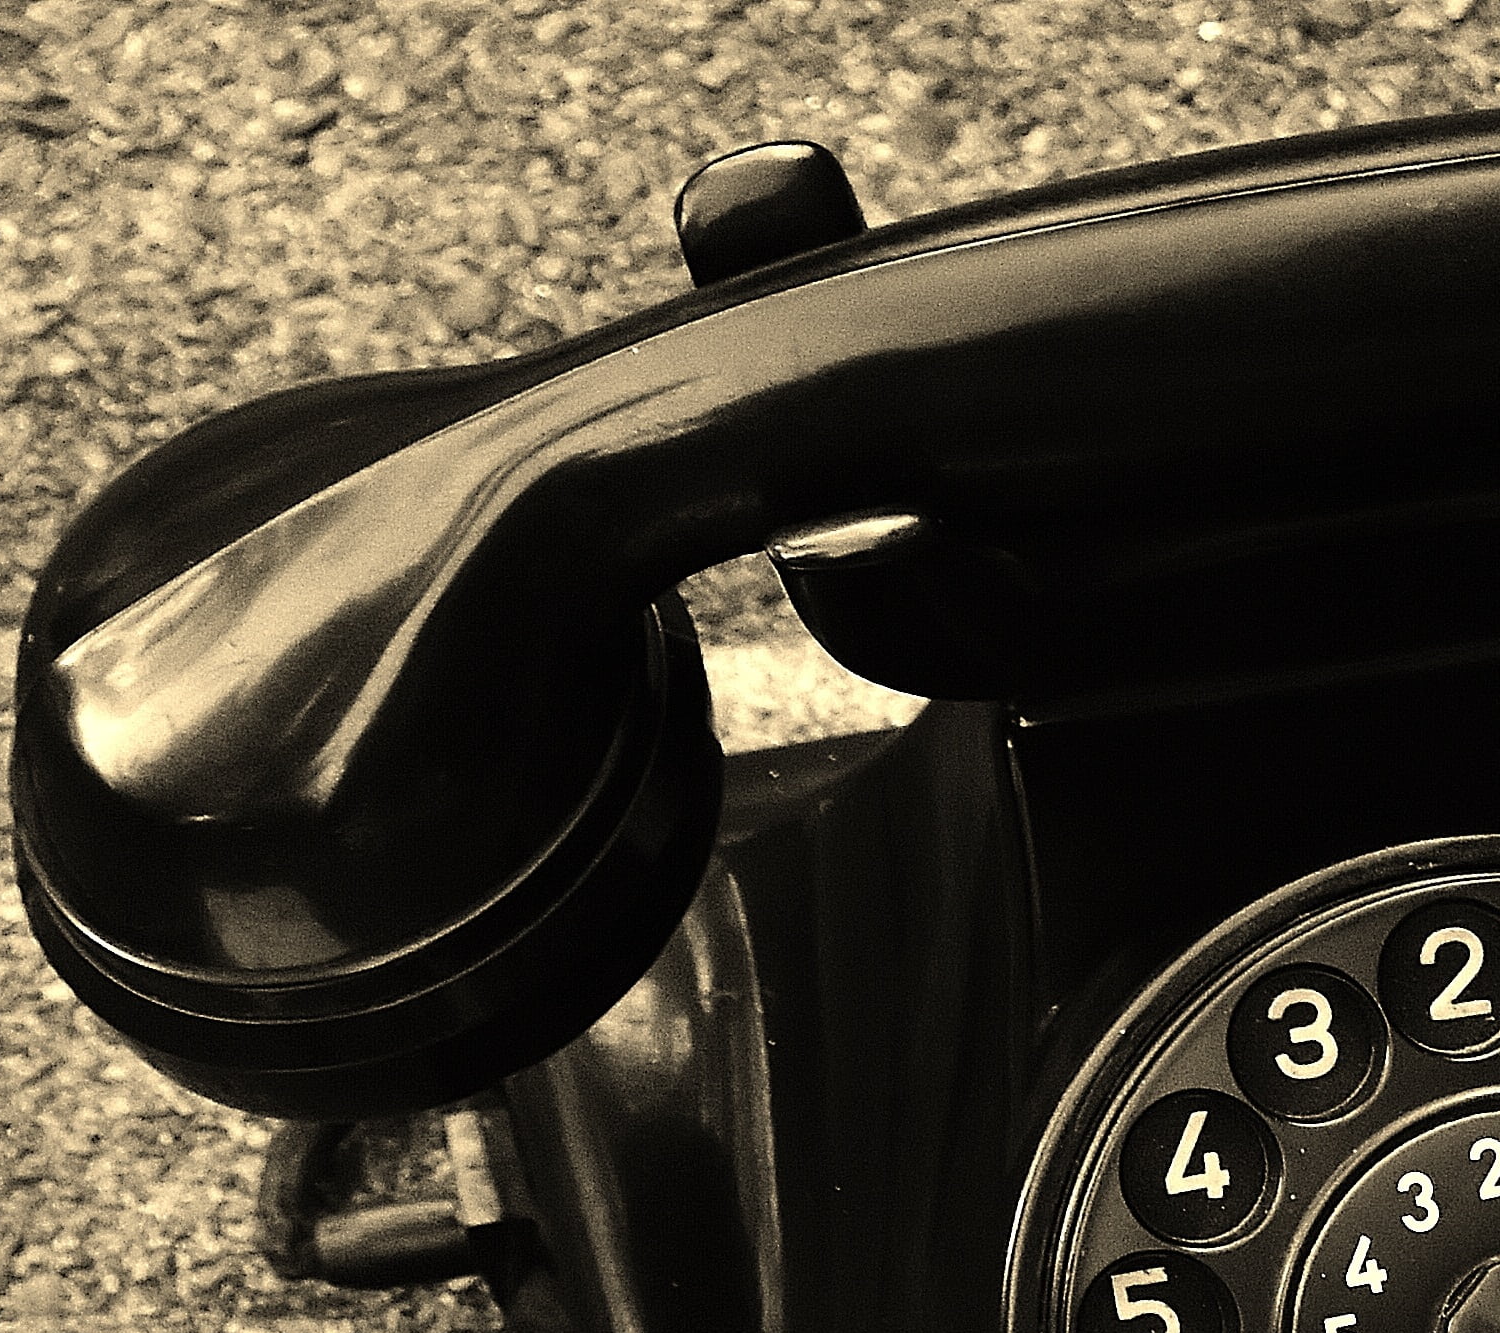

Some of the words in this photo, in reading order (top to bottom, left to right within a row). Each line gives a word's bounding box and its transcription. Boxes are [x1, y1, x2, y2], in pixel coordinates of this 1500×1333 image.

[1419, 926, 1492, 1020] 2
[1267, 988, 1338, 1080] 3
[1164, 1110, 1230, 1199] 4
[1396, 1171, 1440, 1233] 3
[1345, 1234, 1388, 1294] 4
